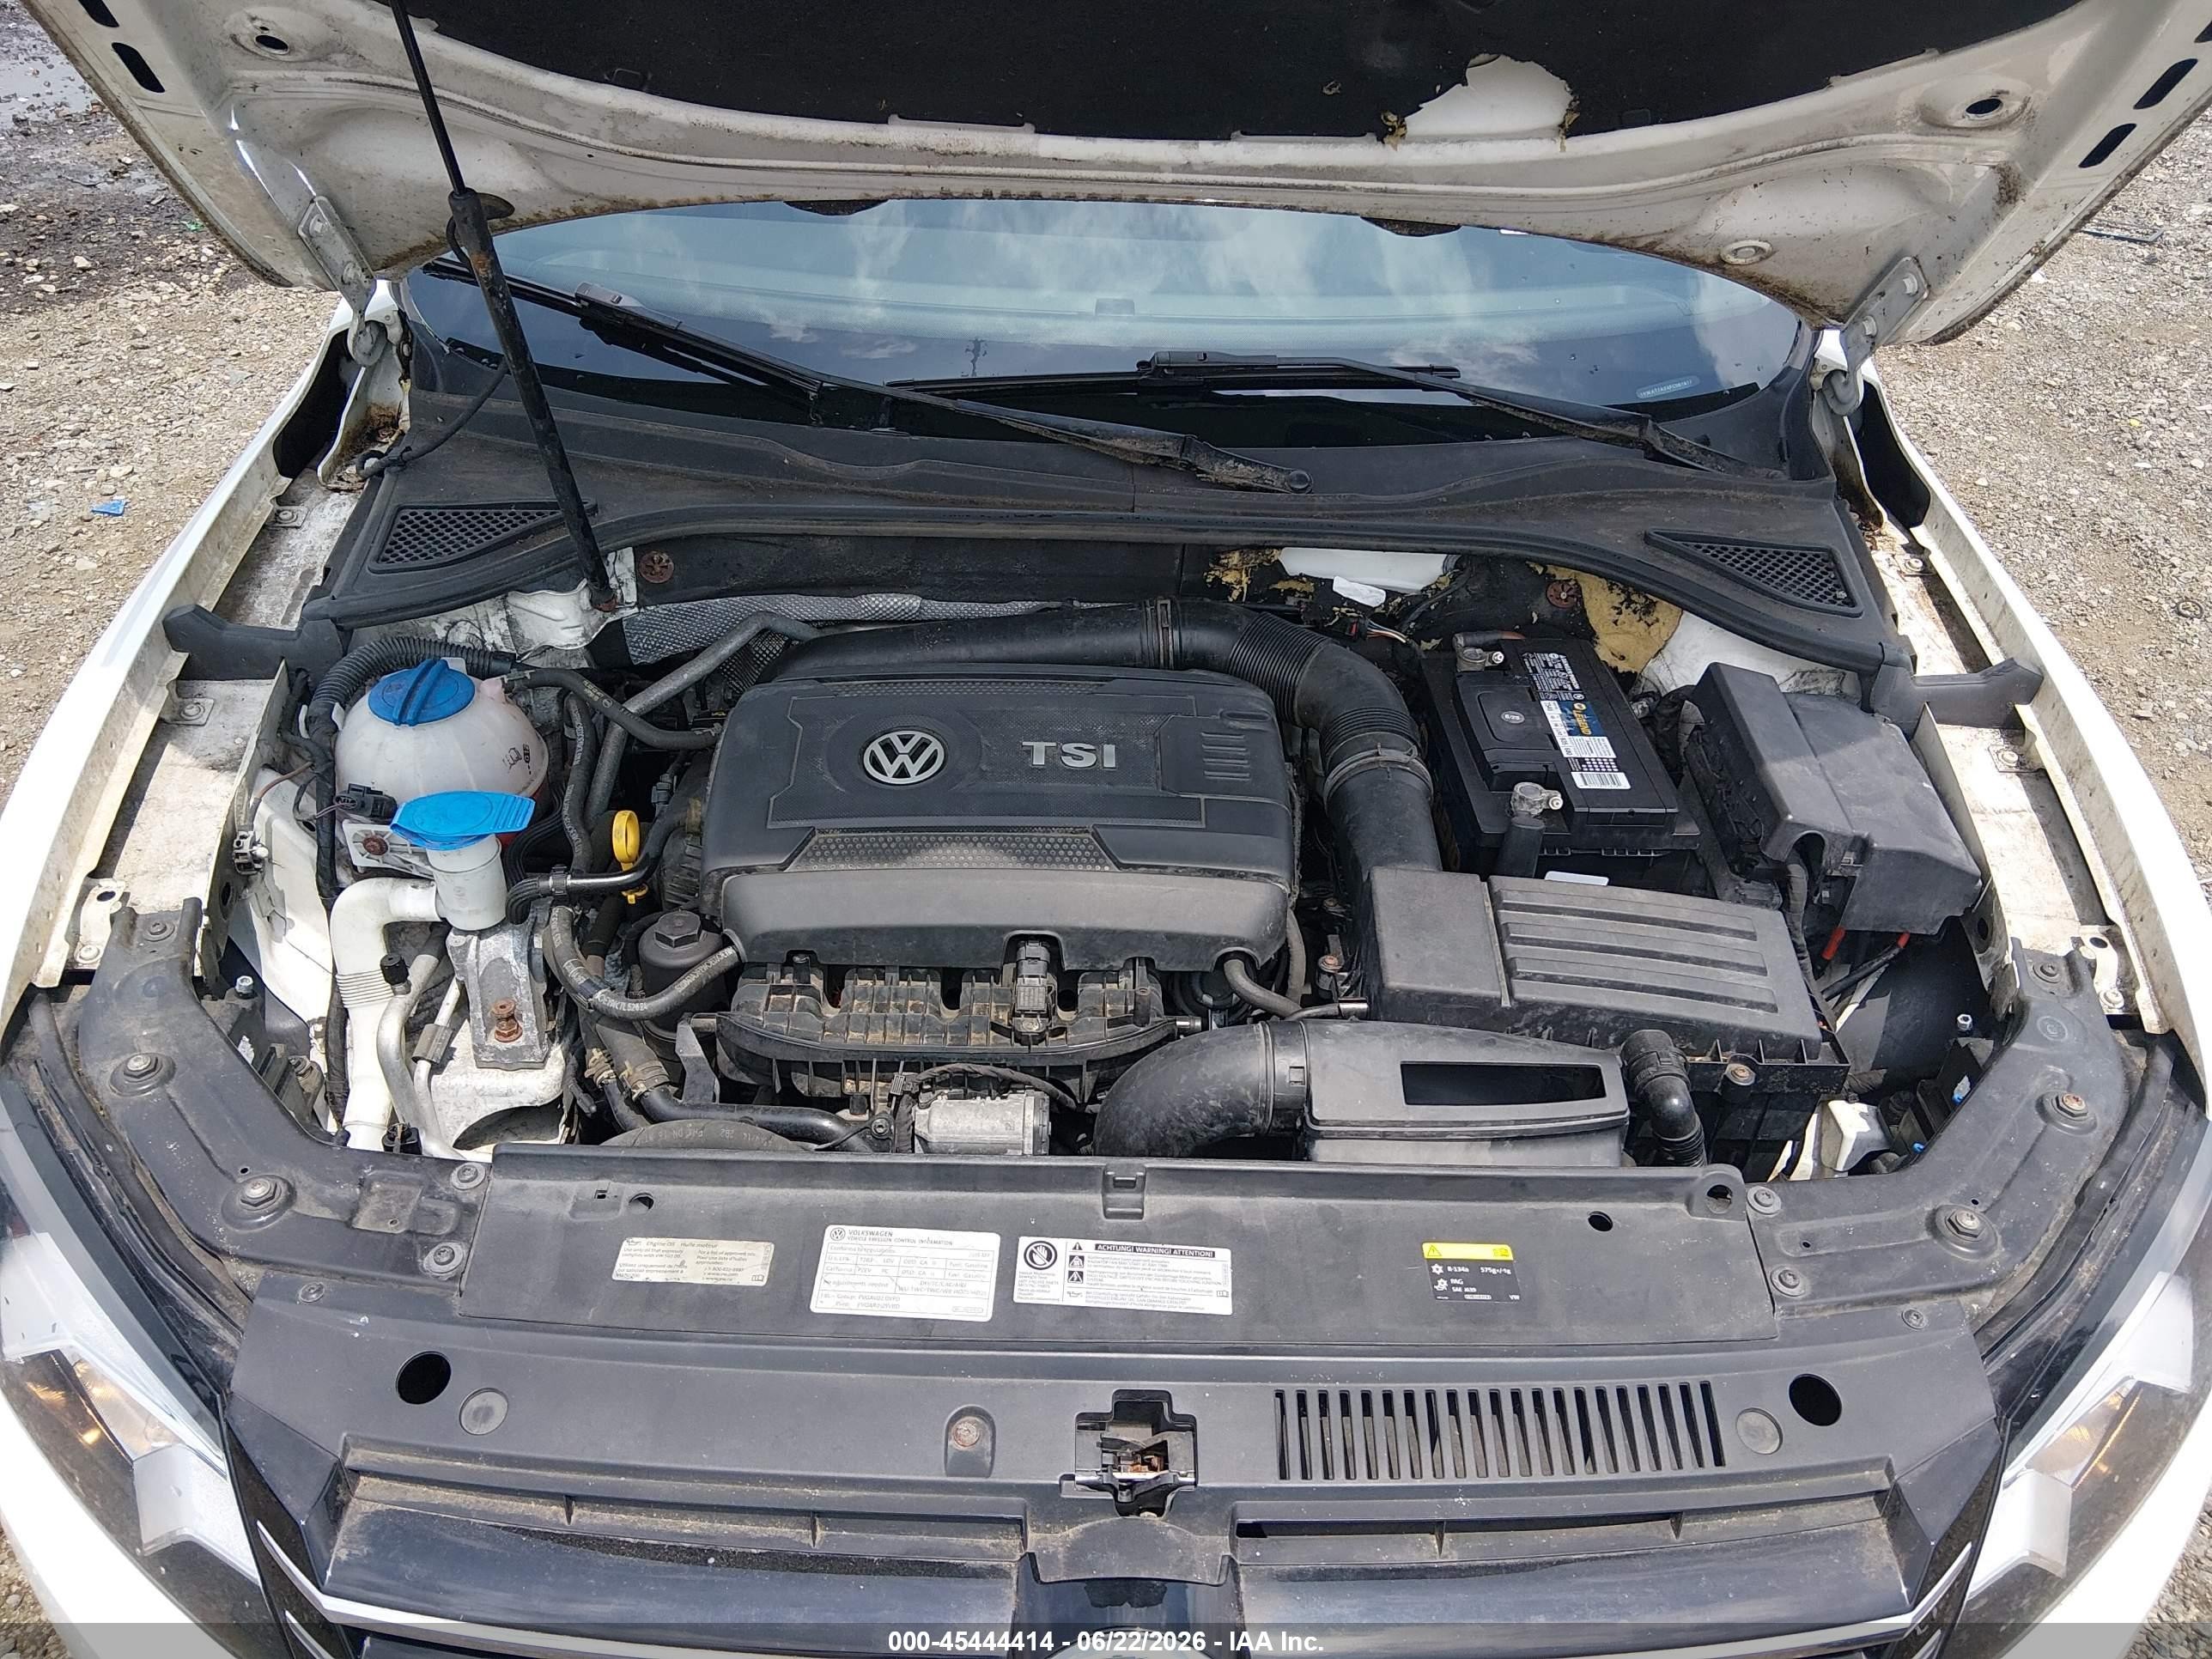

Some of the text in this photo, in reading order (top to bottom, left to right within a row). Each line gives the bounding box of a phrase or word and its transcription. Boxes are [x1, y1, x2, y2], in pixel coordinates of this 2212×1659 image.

[1573, 709, 1591, 735] LEGEND
[1022, 741, 1115, 769] TSI
[1097, 1244, 1213, 1257] ACHTUNG! WARNING! ATTENTION!
